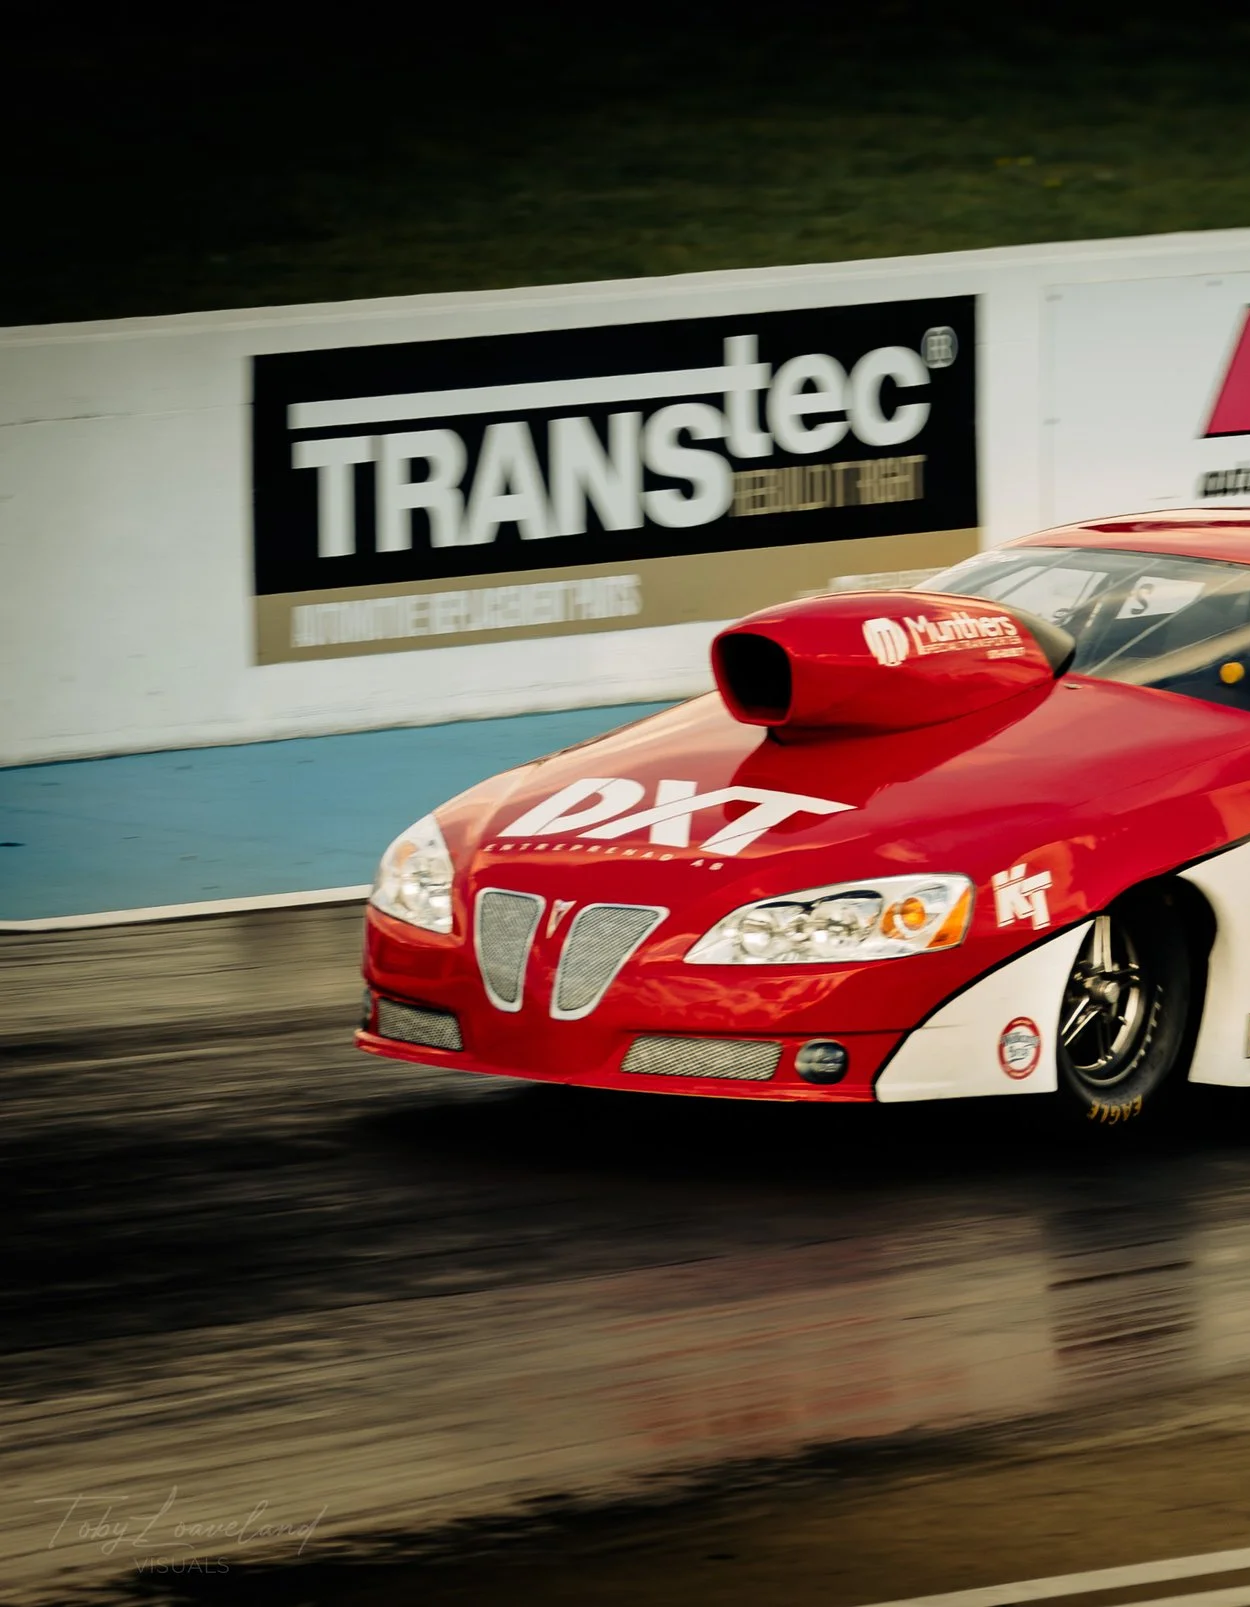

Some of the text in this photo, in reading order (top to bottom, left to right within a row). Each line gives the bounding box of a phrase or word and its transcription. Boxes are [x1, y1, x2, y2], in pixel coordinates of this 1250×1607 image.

[903, 615, 1018, 655] Munthers
[496, 776, 859, 857] DXT
[482, 843, 724, 871] ENTREPRENAD AB
